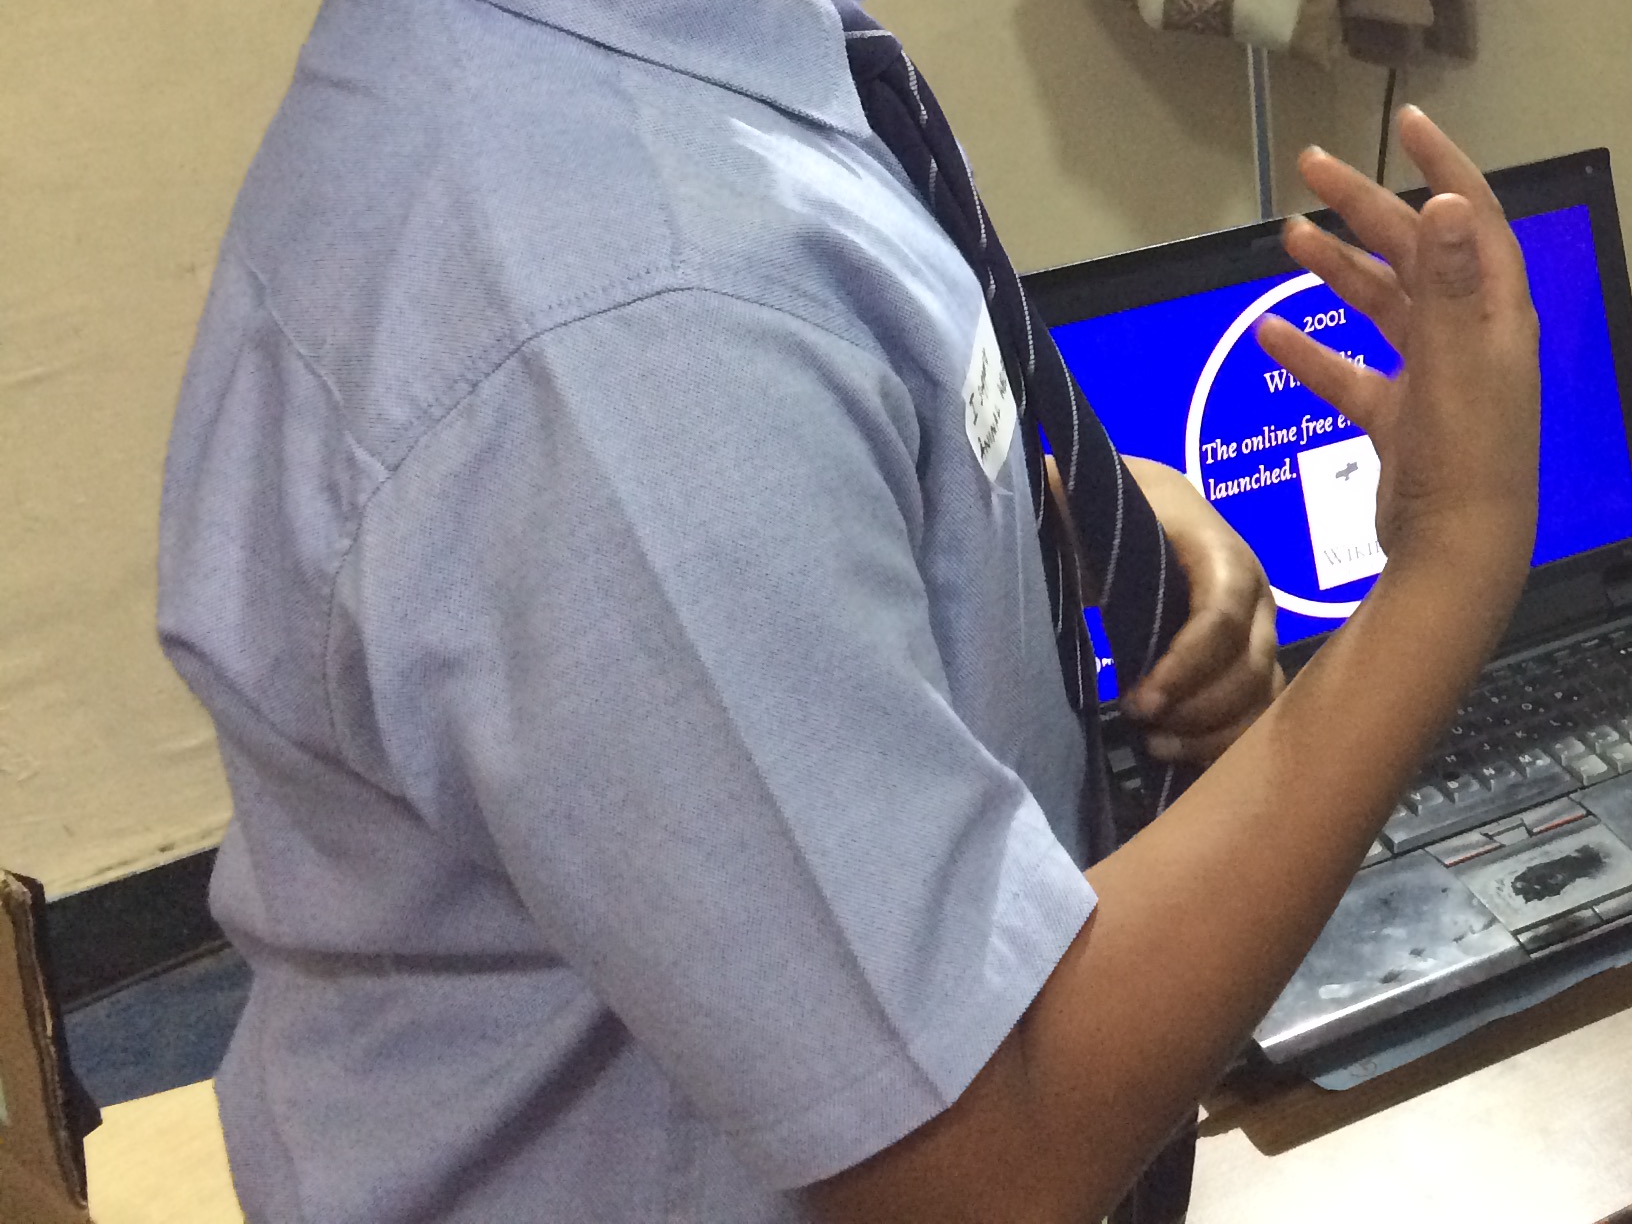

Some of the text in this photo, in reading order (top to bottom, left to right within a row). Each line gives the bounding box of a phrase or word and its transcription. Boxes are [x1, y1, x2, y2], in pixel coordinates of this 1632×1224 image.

[1303, 308, 1347, 333] 2001
[1202, 438, 1238, 465] The
[1241, 425, 1298, 455] online
[1299, 414, 1333, 445] free
[1208, 457, 1297, 501] launched.
